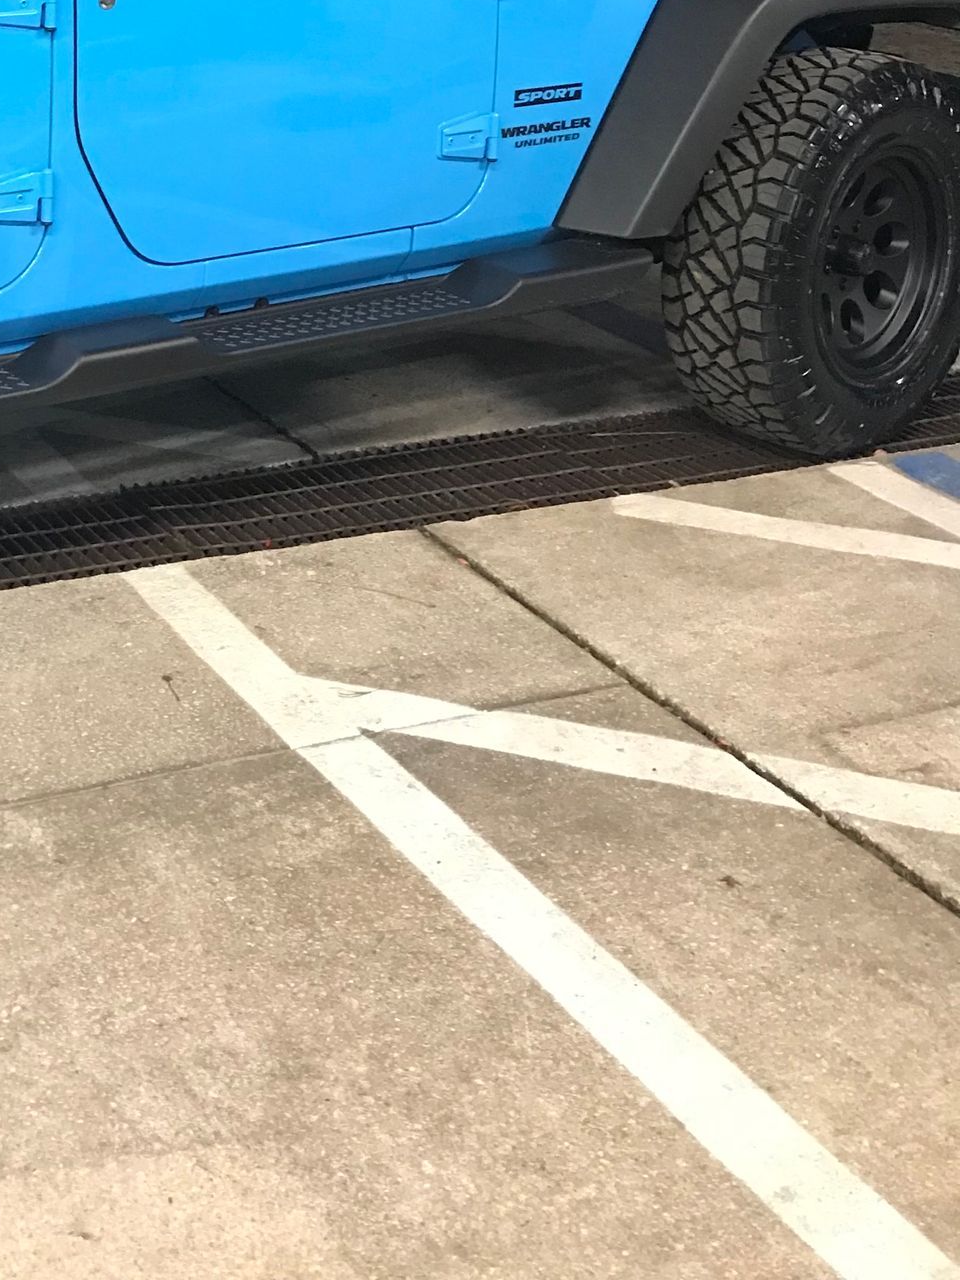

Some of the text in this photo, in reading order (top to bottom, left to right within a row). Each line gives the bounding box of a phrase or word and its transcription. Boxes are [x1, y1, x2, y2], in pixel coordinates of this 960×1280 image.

[516, 86, 582, 104] SPORT
[501, 117, 591, 138] WRANGLER
[514, 133, 580, 148] UNLIMITED
